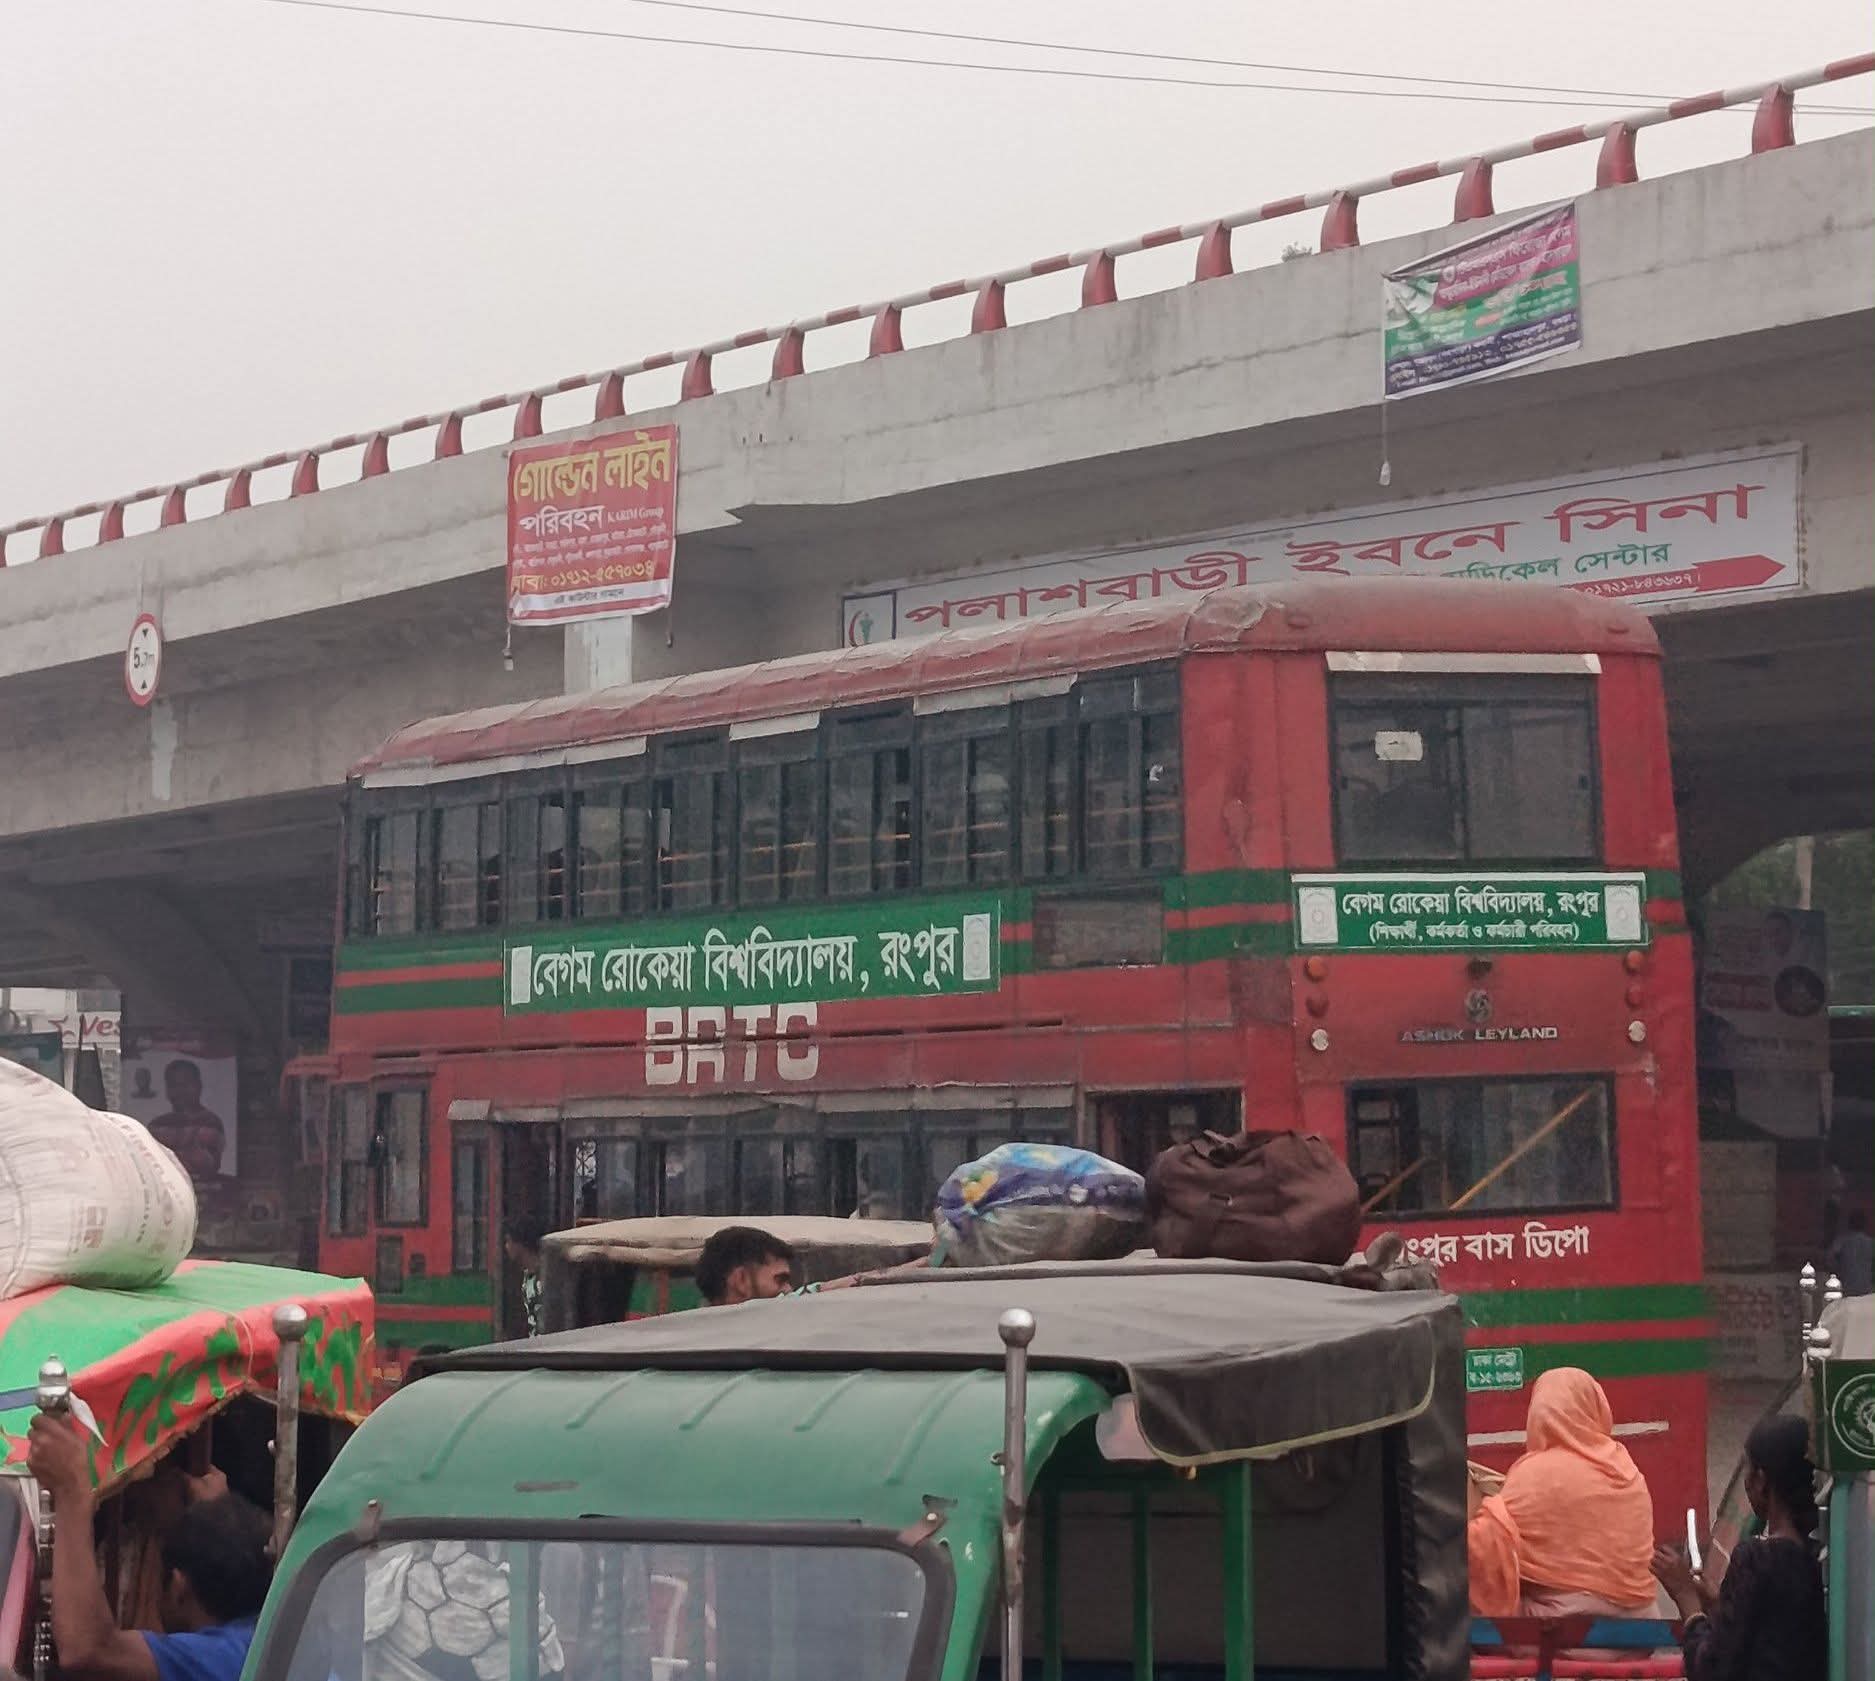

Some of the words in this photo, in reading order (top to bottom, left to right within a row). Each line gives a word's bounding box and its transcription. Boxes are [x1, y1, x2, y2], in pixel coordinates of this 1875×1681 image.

[603, 431, 672, 491] লাইন
[519, 505, 605, 537] পরিবহন
[1284, 520, 1523, 576] ইবনে
[1543, 483, 1766, 544] সিনা
[1575, 543, 1672, 574] সেন্টার
[1342, 891, 1385, 916] বেগম
[1389, 892, 1450, 915] রোকেয়া
[533, 945, 595, 997] বেগম
[601, 942, 695, 991] রোকেয়া
[878, 922, 960, 991] রংপুর
[645, 1001, 819, 1086] BRTC
[1475, 1026, 1558, 1041] LEYLAND
[1395, 1233, 1459, 1268] ংপুর
[1462, 1231, 1515, 1261] বাস
[1522, 1220, 1589, 1259] ডিপো
